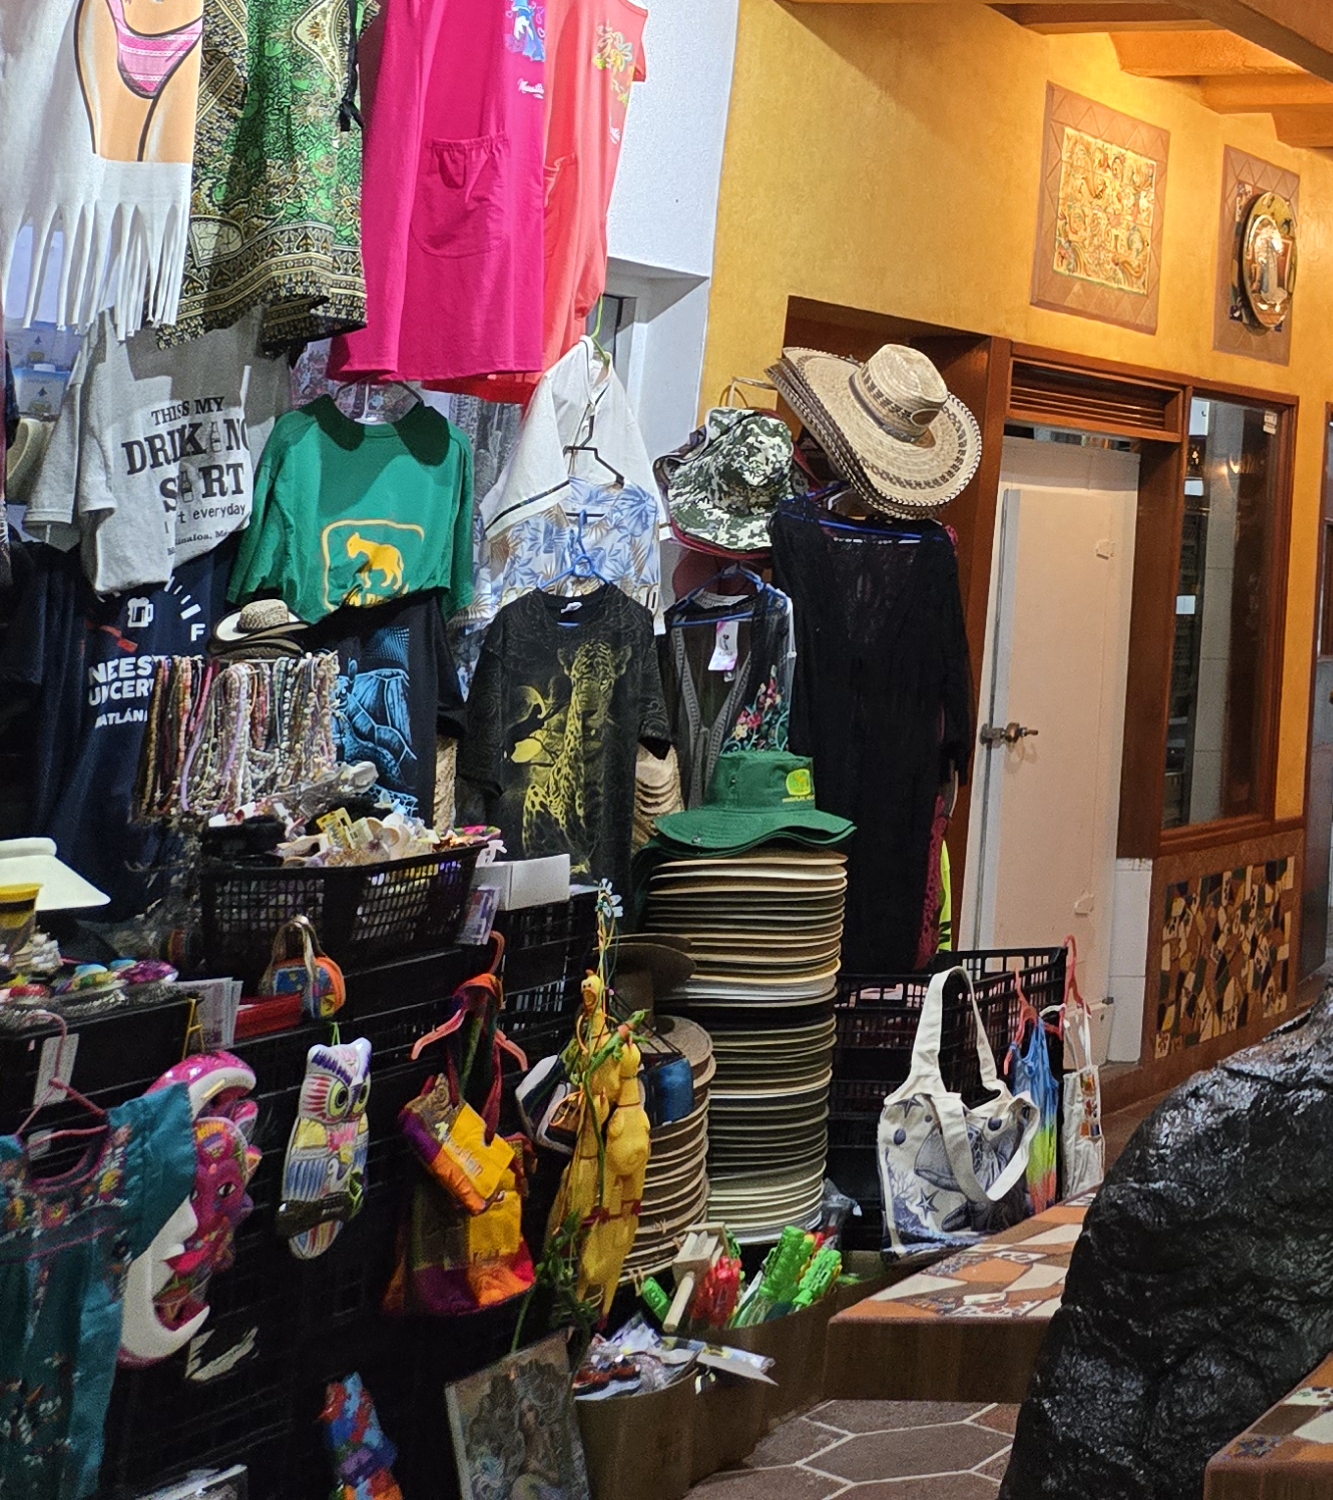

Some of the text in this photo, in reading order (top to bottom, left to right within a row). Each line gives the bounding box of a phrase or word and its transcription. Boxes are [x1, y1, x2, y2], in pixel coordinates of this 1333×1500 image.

[194, 396, 225, 415] MY
[192, 502, 246, 519] everyday
[191, 623, 206, 642] F
